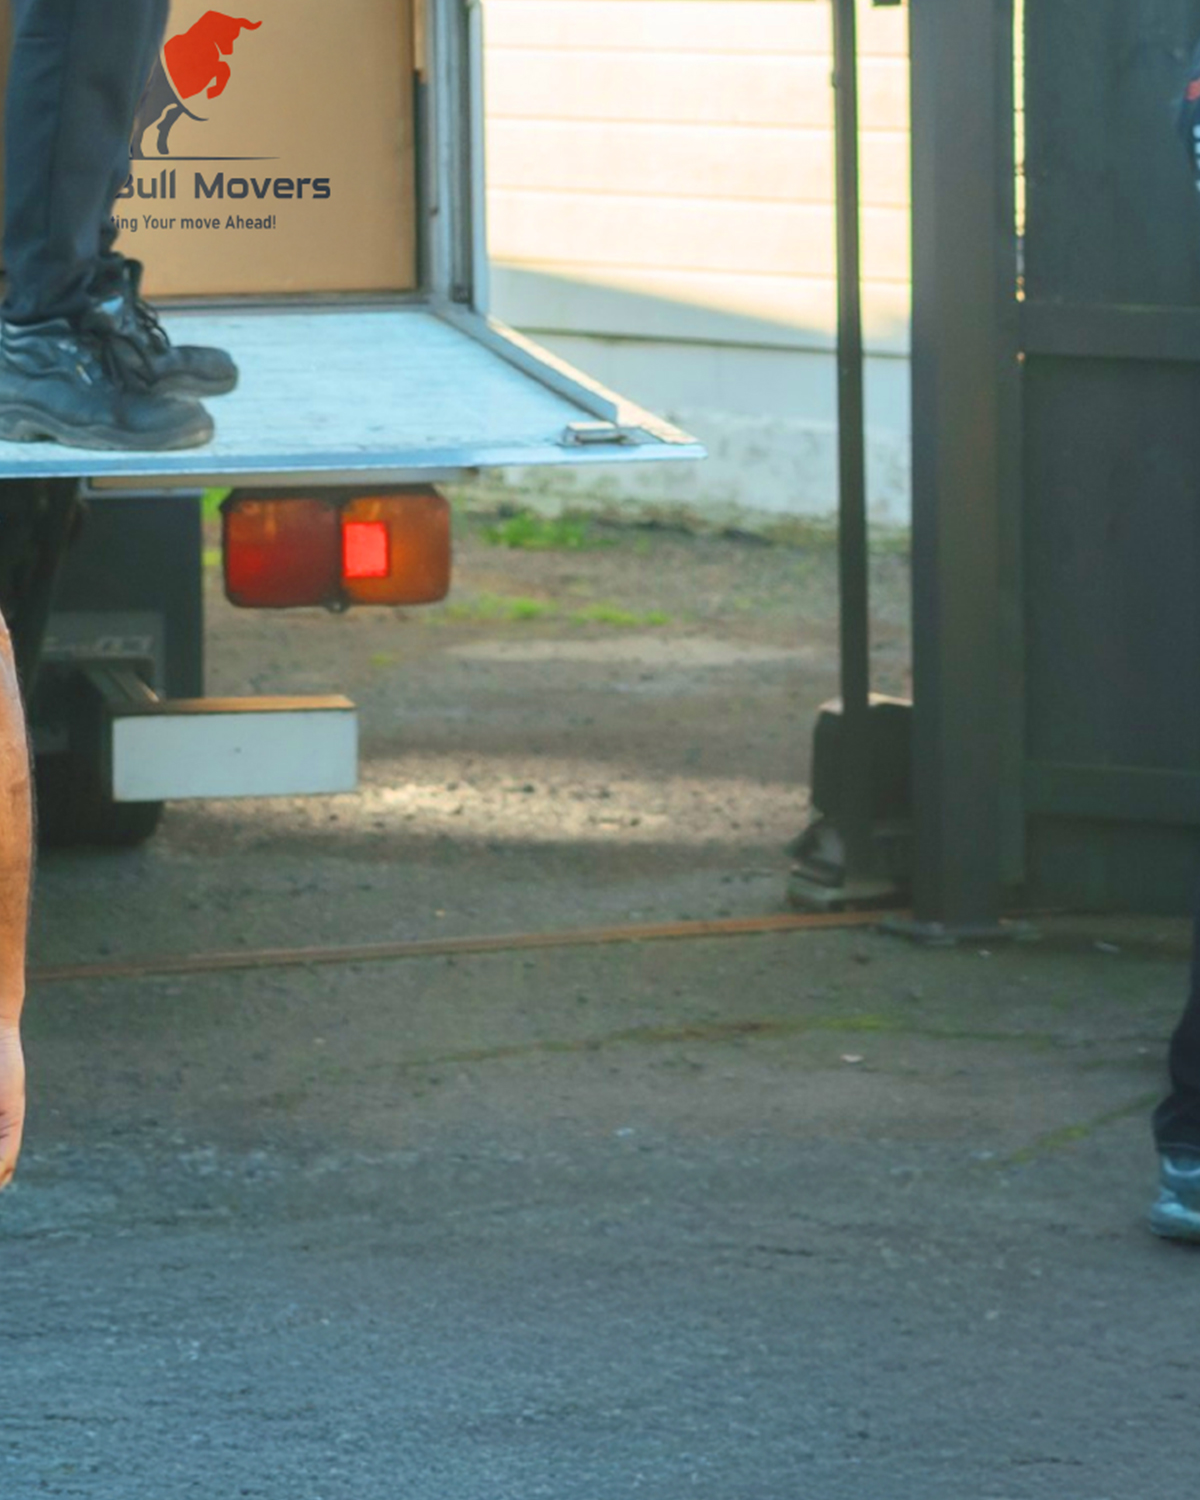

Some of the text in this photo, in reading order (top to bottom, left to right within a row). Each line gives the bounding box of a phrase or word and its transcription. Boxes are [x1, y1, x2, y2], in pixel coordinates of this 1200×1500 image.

[194, 172, 331, 199] Movers
[143, 215, 176, 229] Your
[180, 218, 221, 229] move
[225, 215, 277, 229] Ahead!
